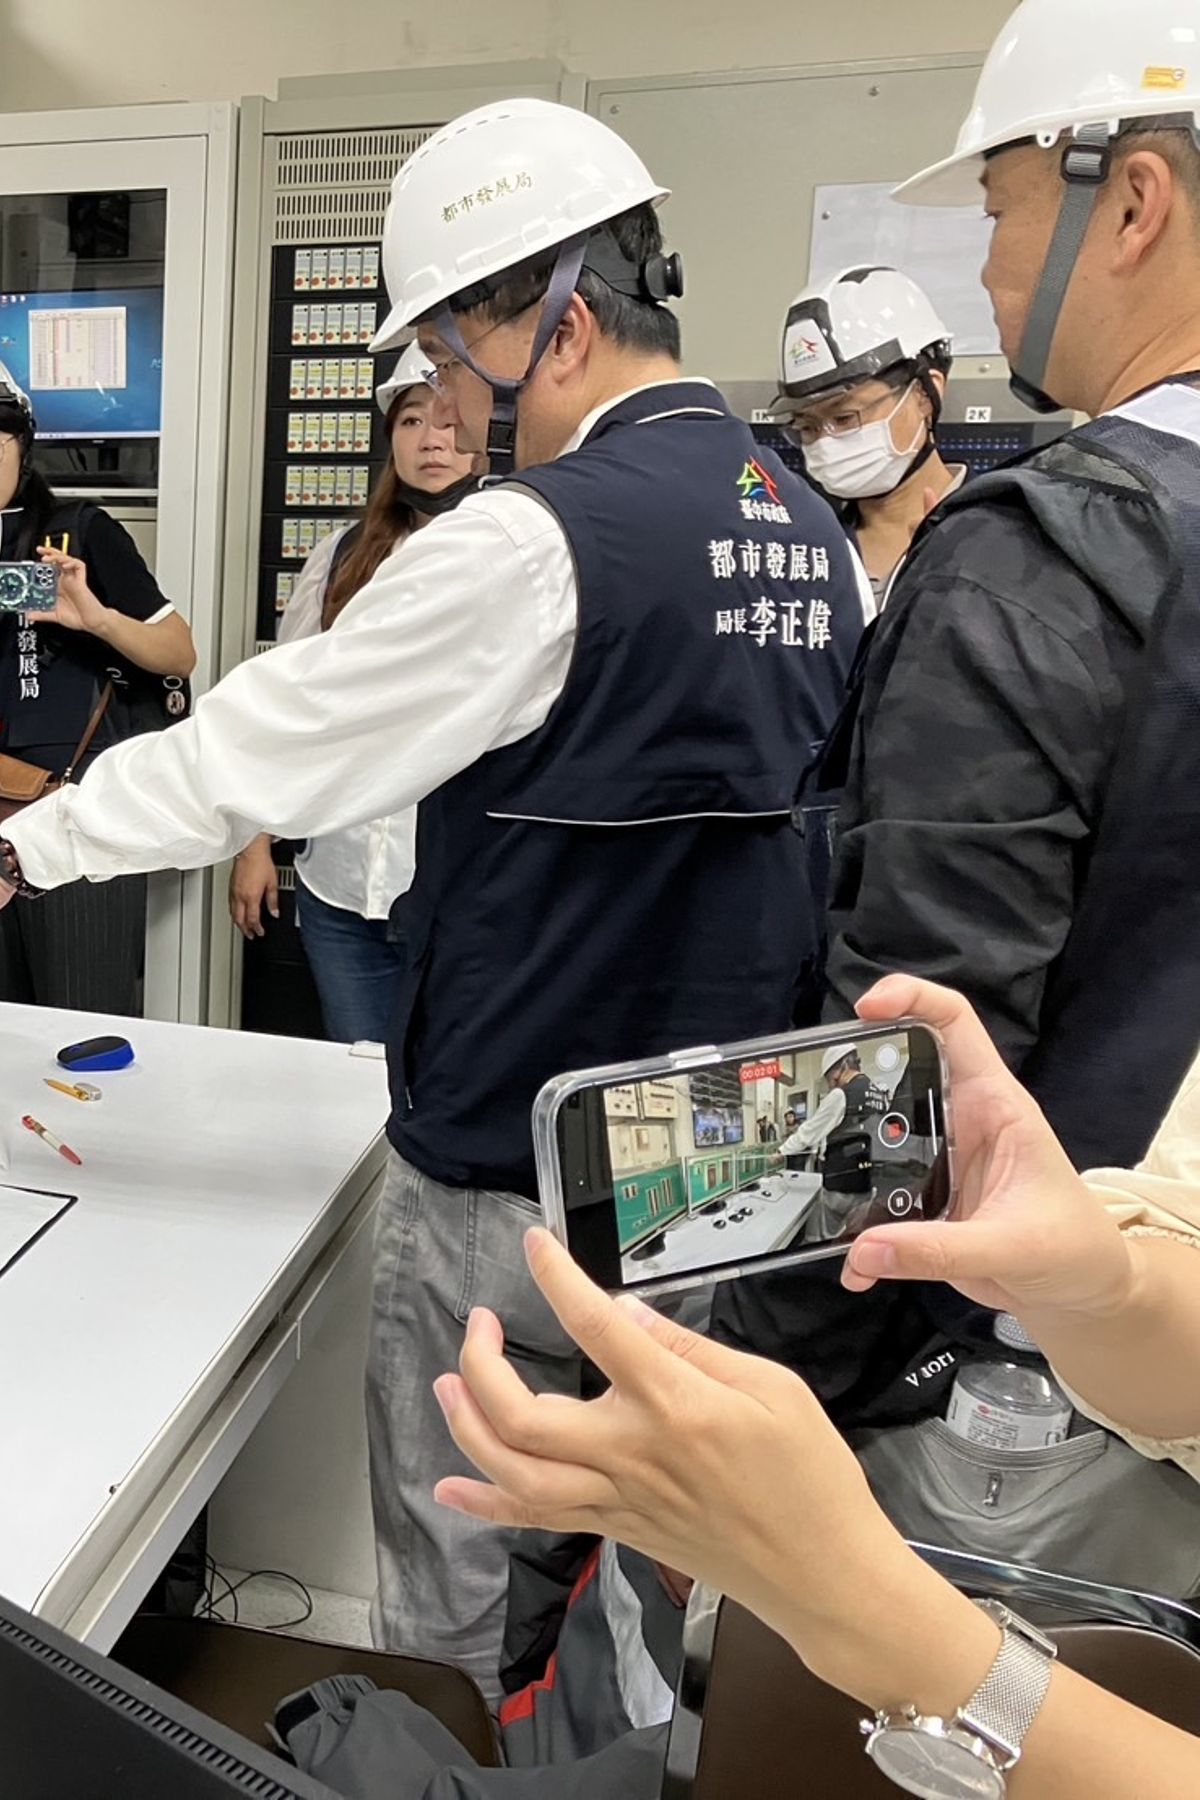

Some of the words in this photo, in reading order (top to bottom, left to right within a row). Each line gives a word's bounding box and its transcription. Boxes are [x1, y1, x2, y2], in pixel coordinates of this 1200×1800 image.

[441, 171, 532, 224] 都市發展局
[968, 409, 987, 421] 2K
[708, 538, 830, 582] 都市發展局
[715, 608, 748, 636] 局長
[749, 596, 833, 650] 李正偉
